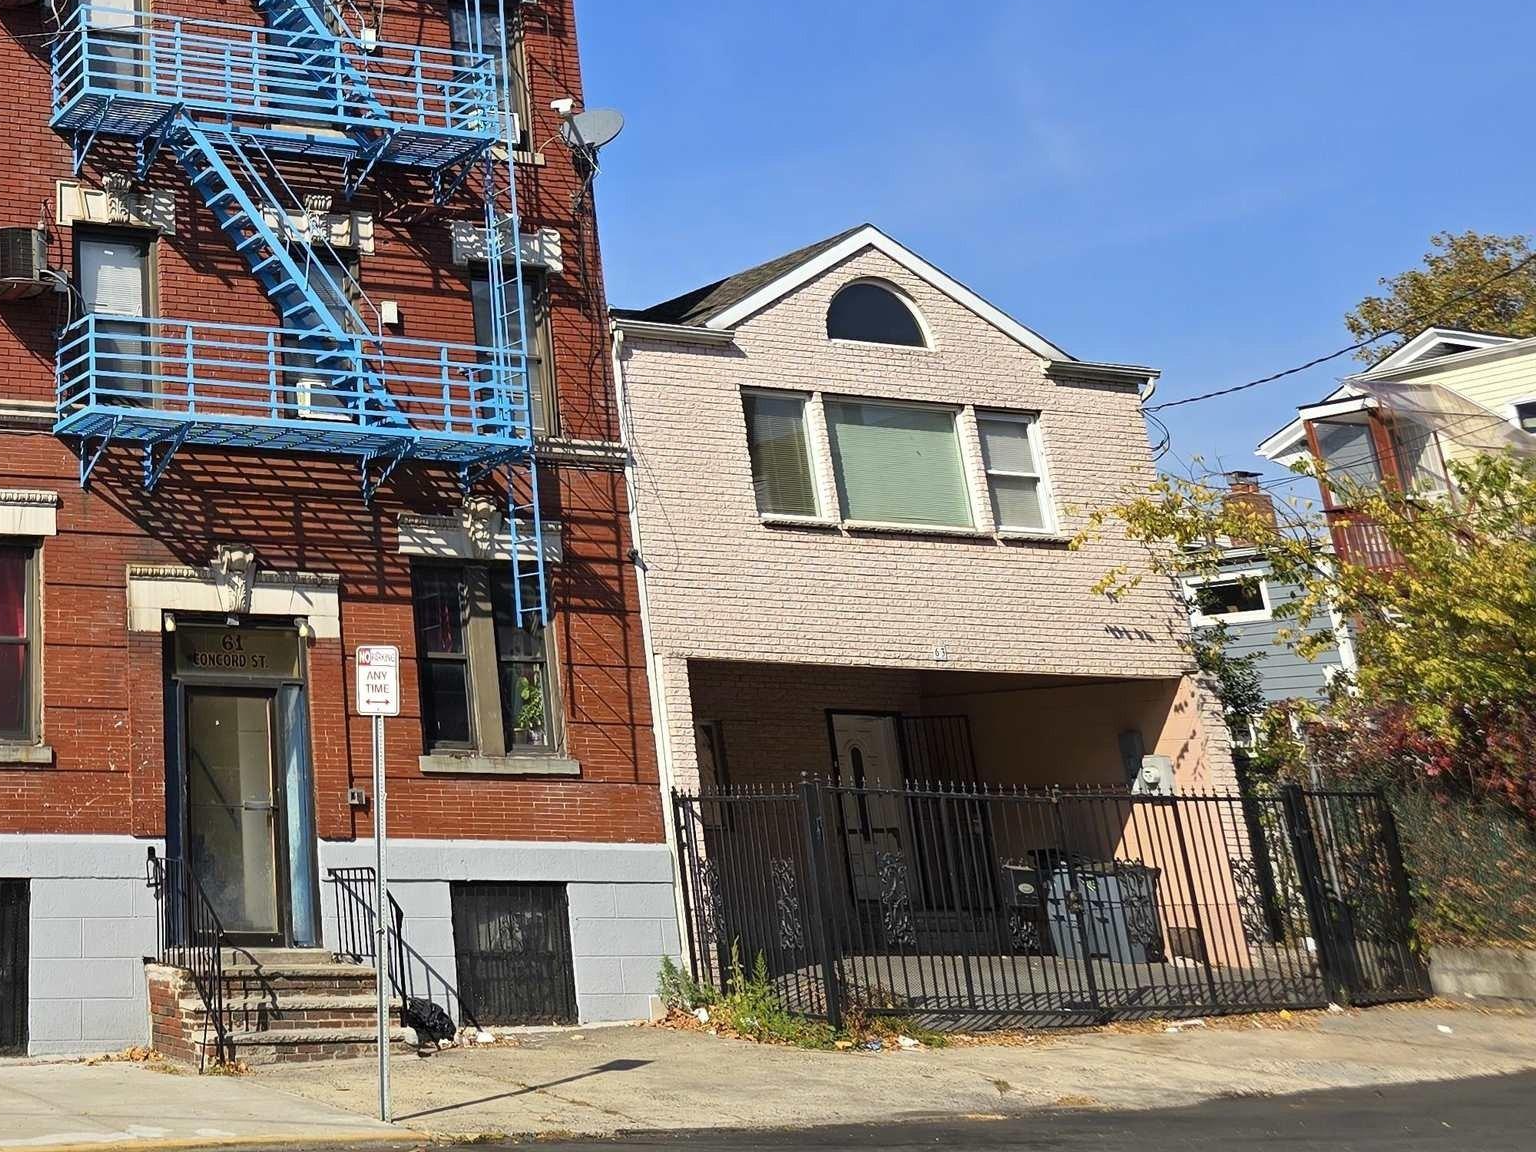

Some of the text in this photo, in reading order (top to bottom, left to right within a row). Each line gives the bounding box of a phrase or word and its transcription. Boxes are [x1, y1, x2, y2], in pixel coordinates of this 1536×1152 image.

[222, 634, 244, 651] 61
[193, 651, 269, 668] CONCORD ST.
[359, 650, 371, 664] NO
[366, 671, 388, 681] ANY
[365, 684, 390, 694] TIME
